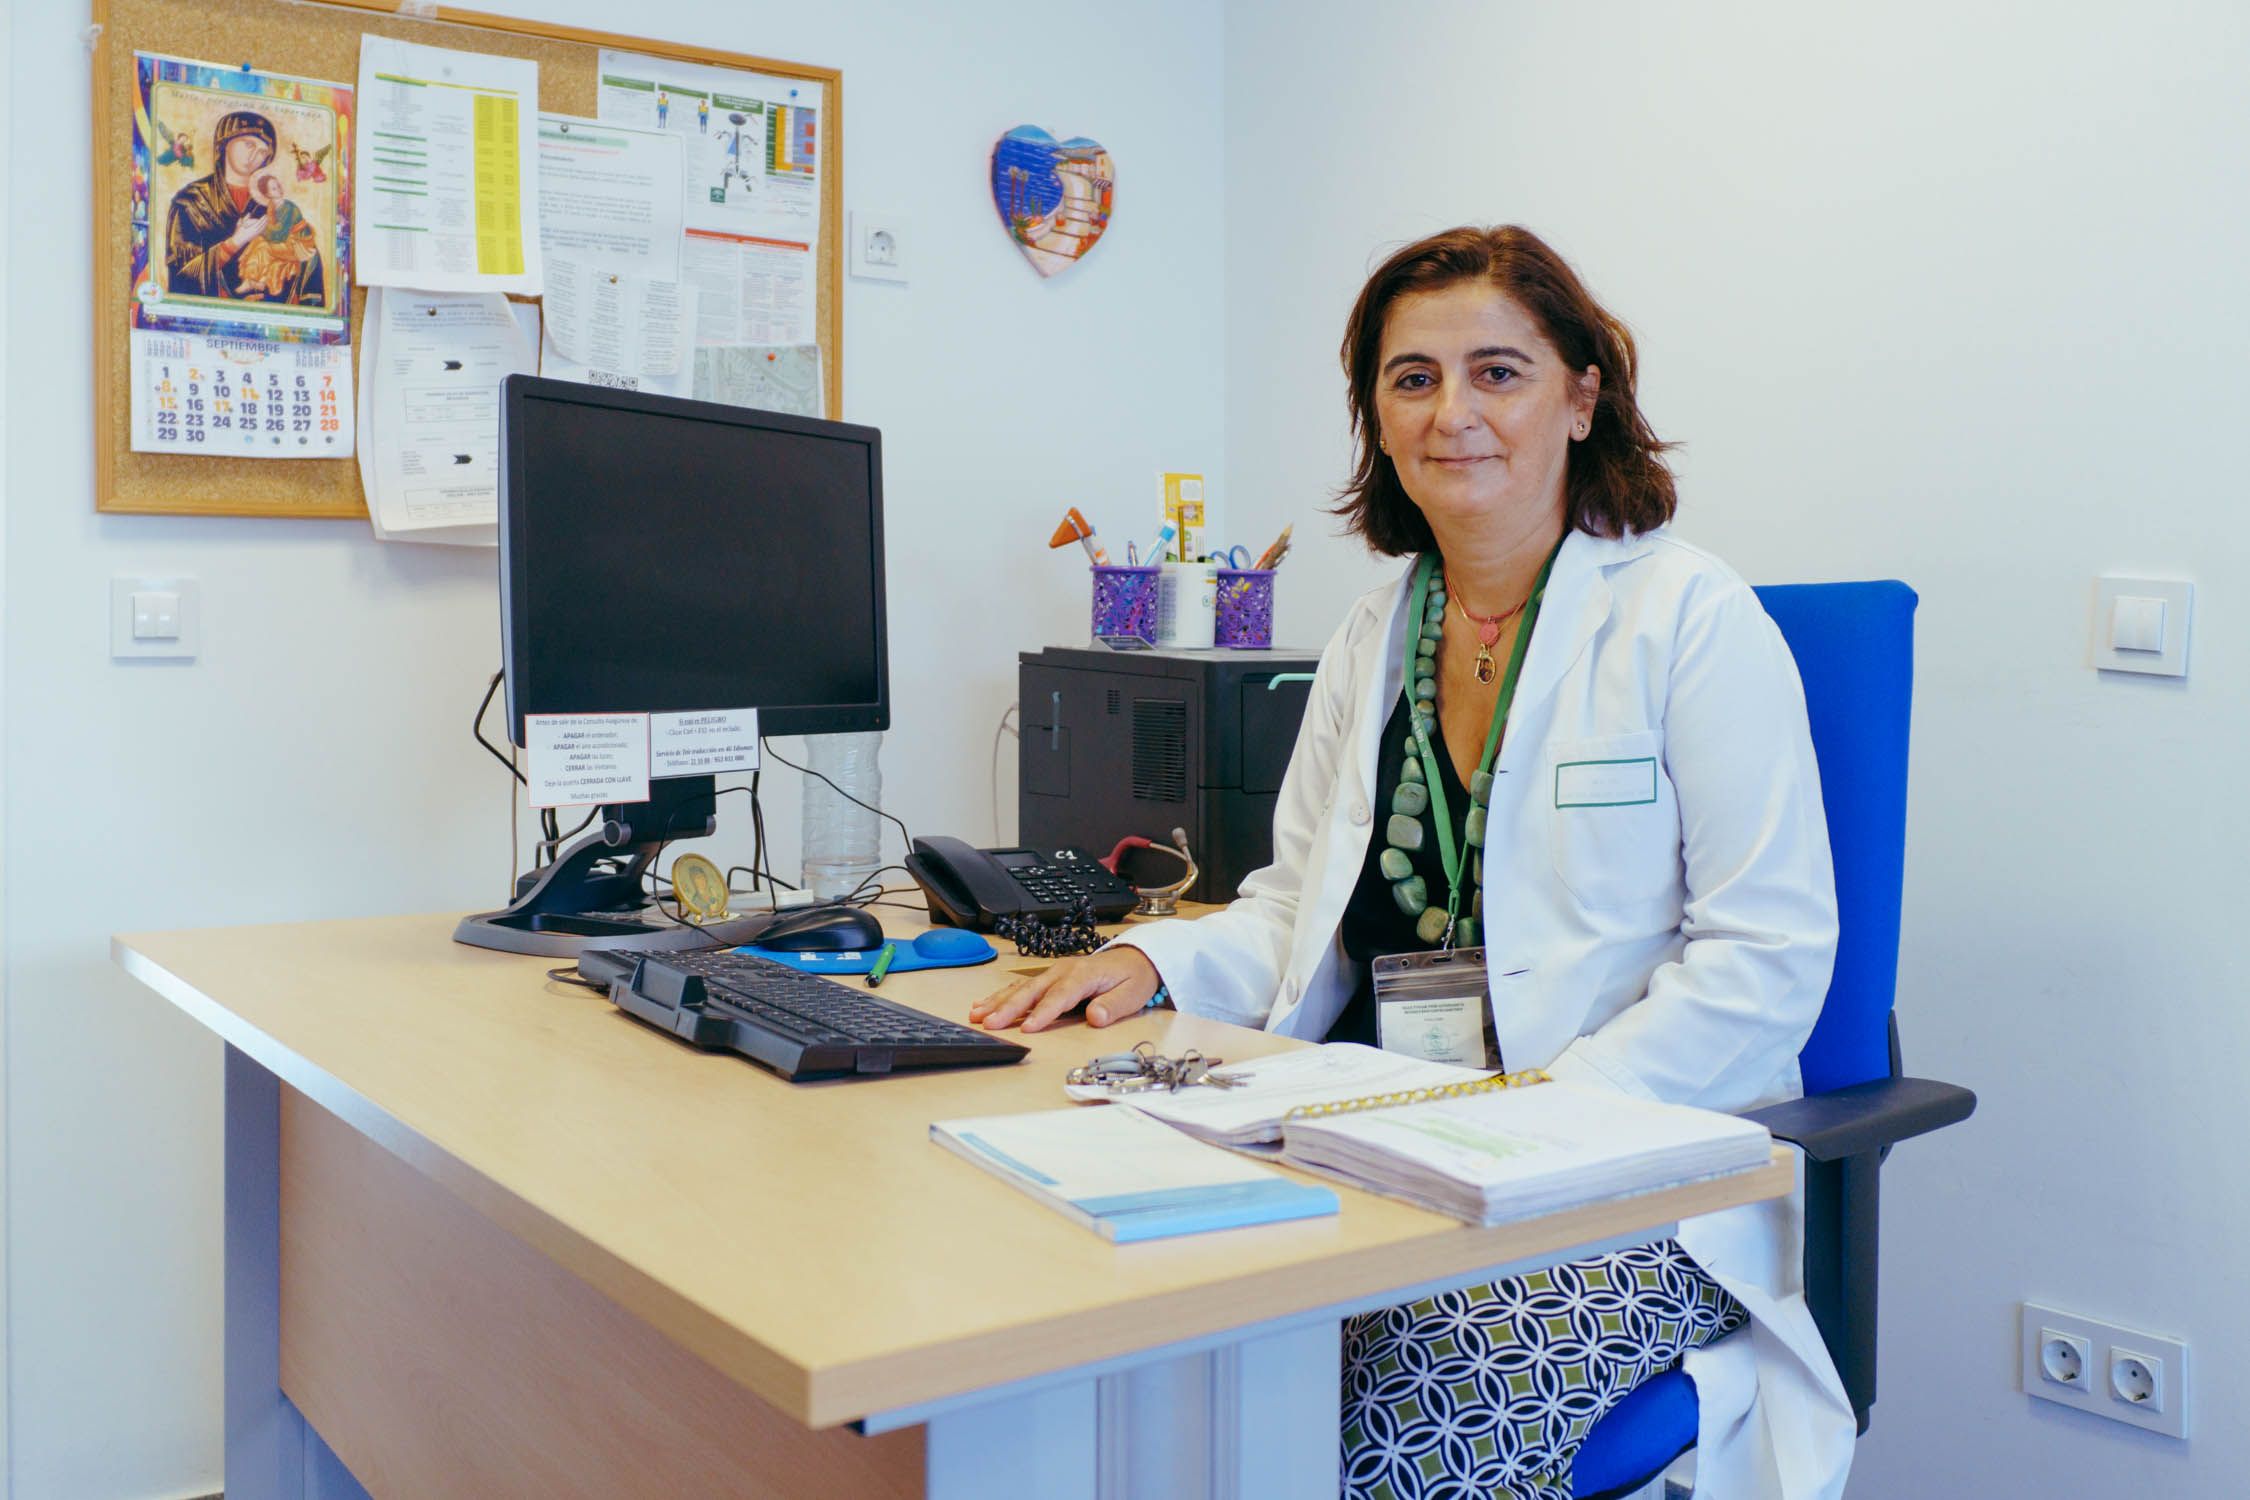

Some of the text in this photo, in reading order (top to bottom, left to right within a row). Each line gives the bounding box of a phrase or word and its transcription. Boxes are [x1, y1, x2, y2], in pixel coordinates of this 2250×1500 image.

[206, 338, 281, 353] SEPTIEMBRE
[162, 366, 333, 387] 1 2 3 4 5 6 7
[161, 380, 171, 393] 8
[189, 383, 199, 396] 9
[213, 385, 230, 398] 10
[266, 389, 284, 401] 12
[293, 390, 310, 402] 13
[319, 390, 336, 402] 14
[186, 399, 204, 411] 16
[241, 402, 257, 415] 18
[267, 404, 284, 416] 19
[293, 404, 311, 416] 20
[319, 404, 336, 417] 21
[157, 411, 339, 431] 22 23 24 25 26 27 28
[157, 427, 205, 442] 29 30
[580, 777, 604, 785] CERRADA
